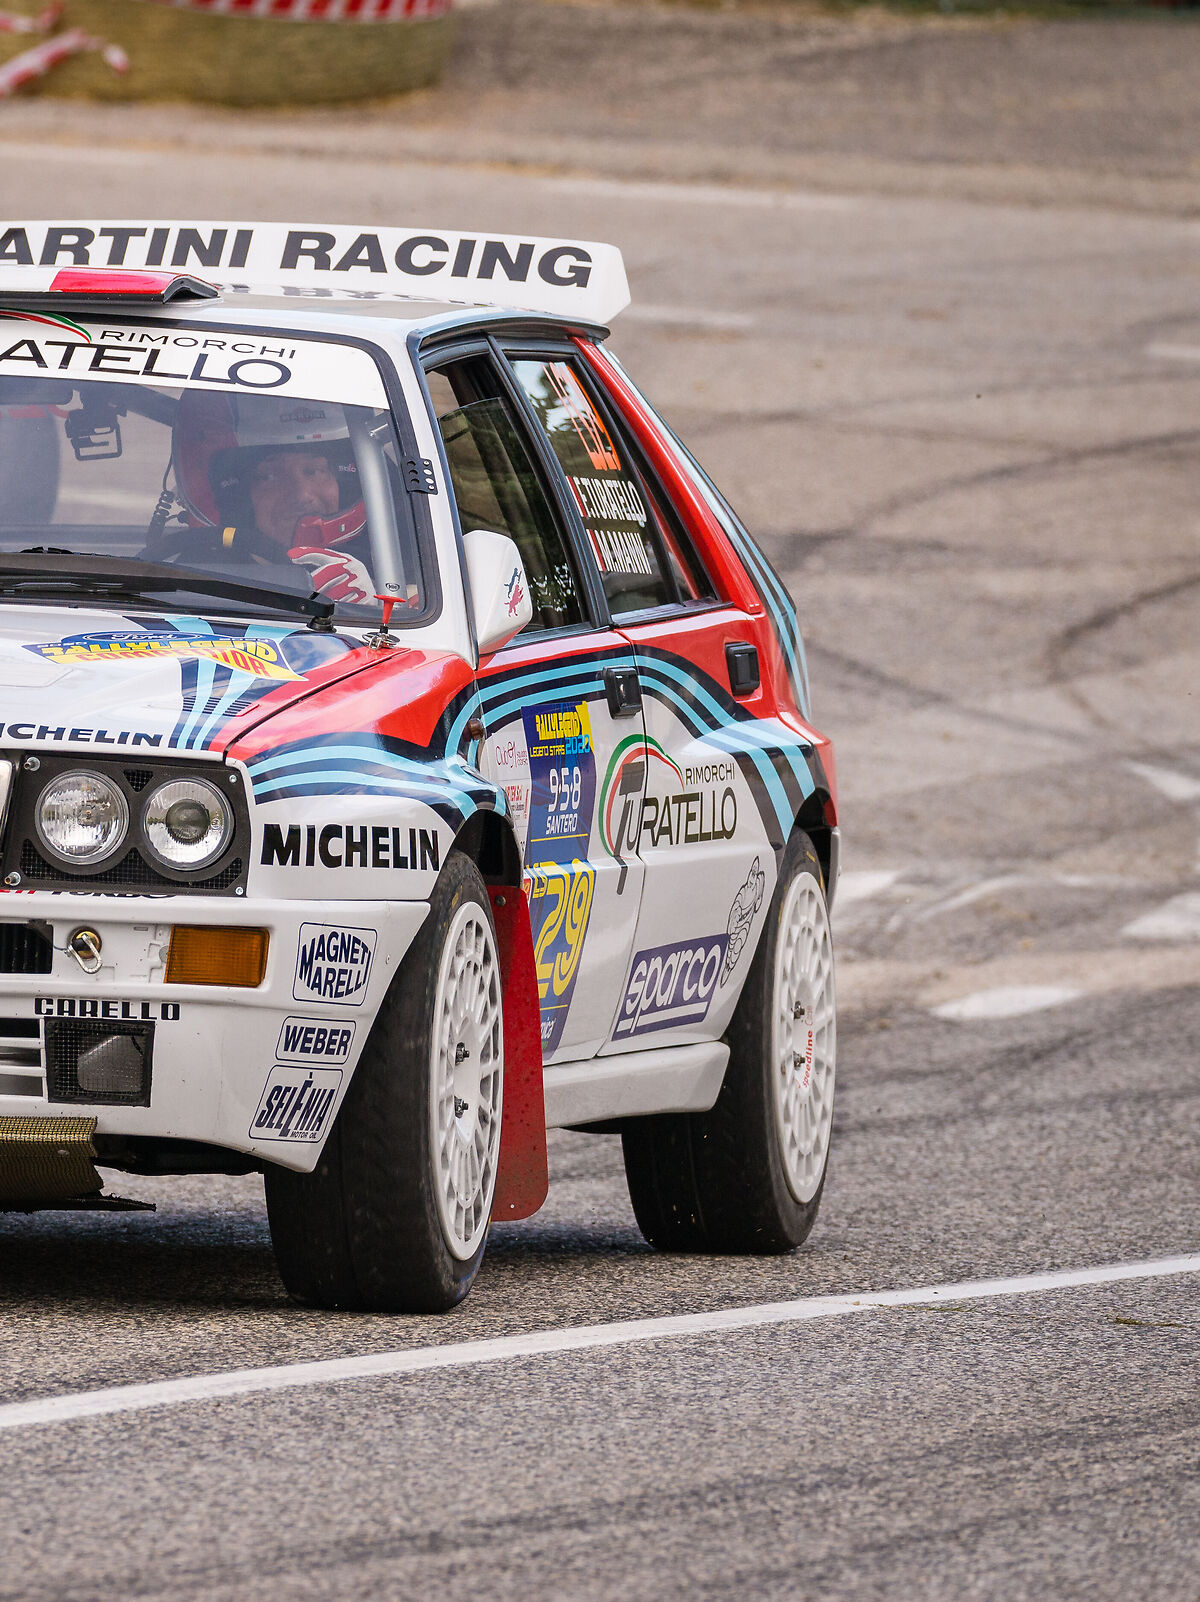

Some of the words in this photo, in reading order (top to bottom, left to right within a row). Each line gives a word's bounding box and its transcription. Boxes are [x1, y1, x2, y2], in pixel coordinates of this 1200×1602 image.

[280, 231, 594, 290] RACING
[99, 329, 297, 361] RIMORCHI
[40, 640, 279, 663] RALLYLEGEND
[111, 632, 178, 641] Ford
[76, 648, 271, 677] COMPETITOR
[565, 734, 591, 755] 2020
[685, 765, 737, 786] RIMORCHI
[545, 813, 578, 835] SANTERO
[613, 761, 738, 895] TURATELLO
[260, 823, 440, 872] MICHELIN
[533, 857, 594, 998] 29
[300, 931, 371, 966] MAGNETI
[299, 964, 368, 999] MARELLI
[625, 943, 722, 1034] sparco
[35, 997, 180, 1021] CARELLO
[283, 1024, 350, 1057] WEBER
[290, 1131, 308, 1139] MOTOR
